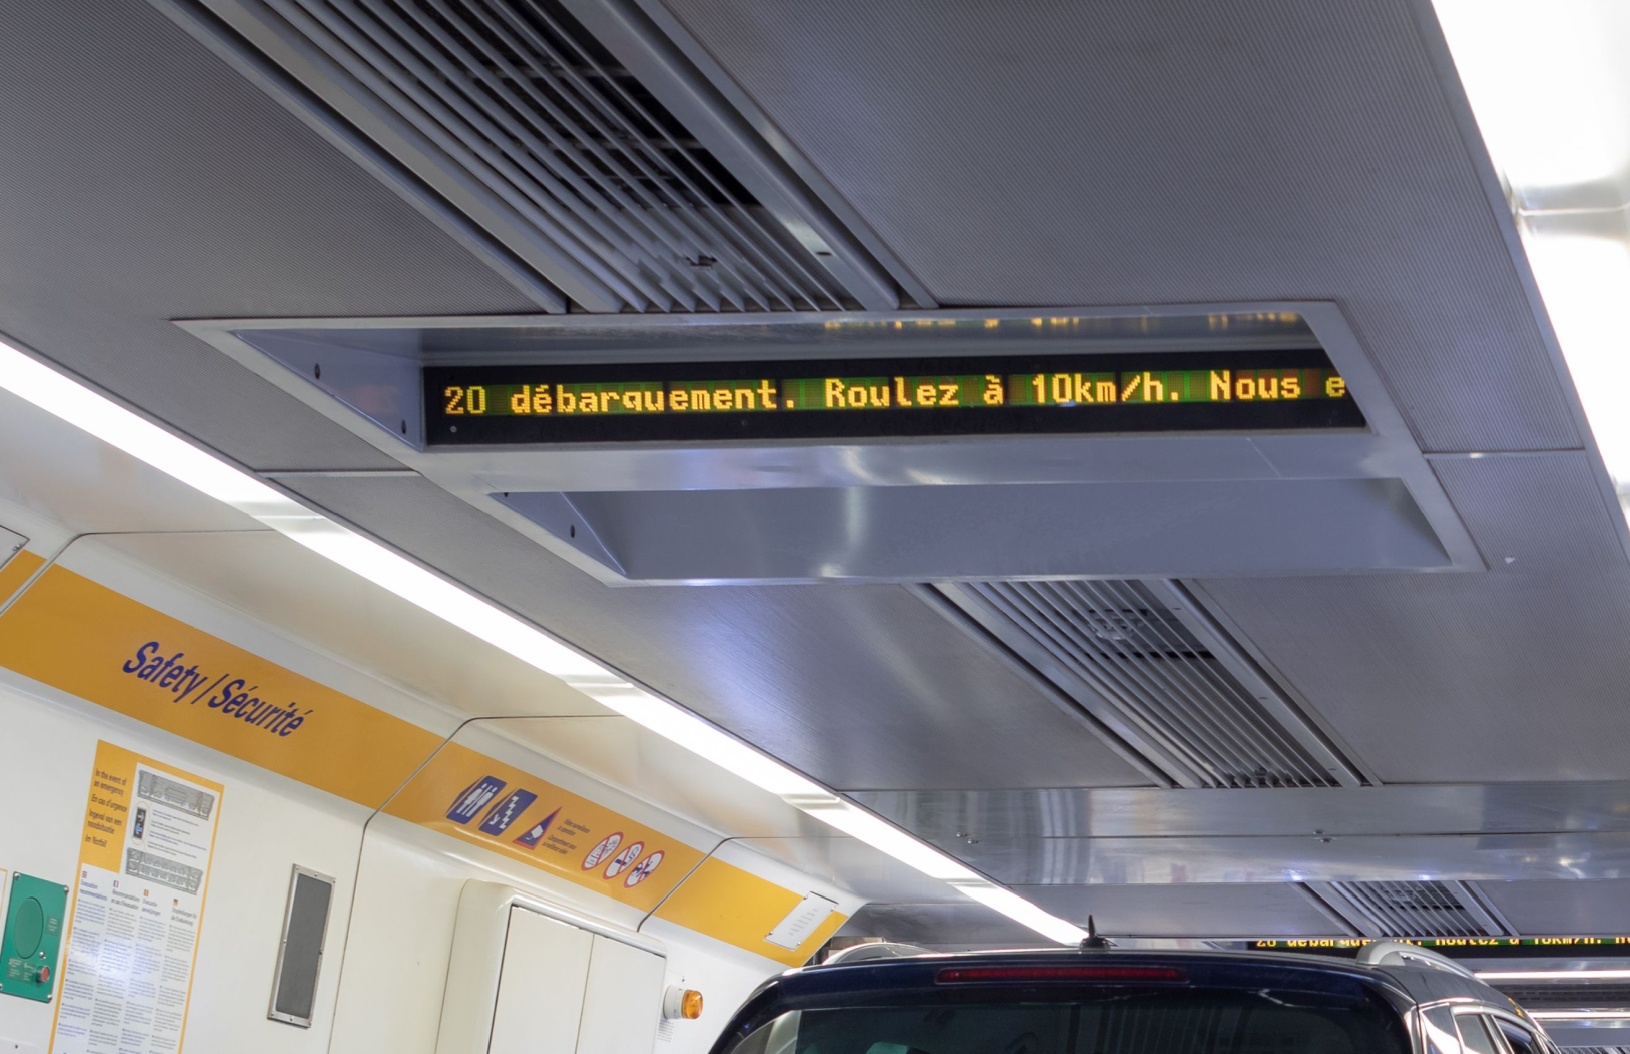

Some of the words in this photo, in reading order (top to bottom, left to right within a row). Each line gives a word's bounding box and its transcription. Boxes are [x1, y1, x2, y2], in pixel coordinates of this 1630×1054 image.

[445, 386, 486, 414] 20
[511, 380, 795, 414] débarquement.
[825, 377, 959, 408] Roulez
[983, 375, 1004, 405] à
[1032, 372, 1180, 404] 10km/h.
[1210, 370, 1301, 401] Nous
[1326, 377, 1346, 398] e
[122, 641, 208, 703] Safety
[208, 678, 314, 737] Sécurité
